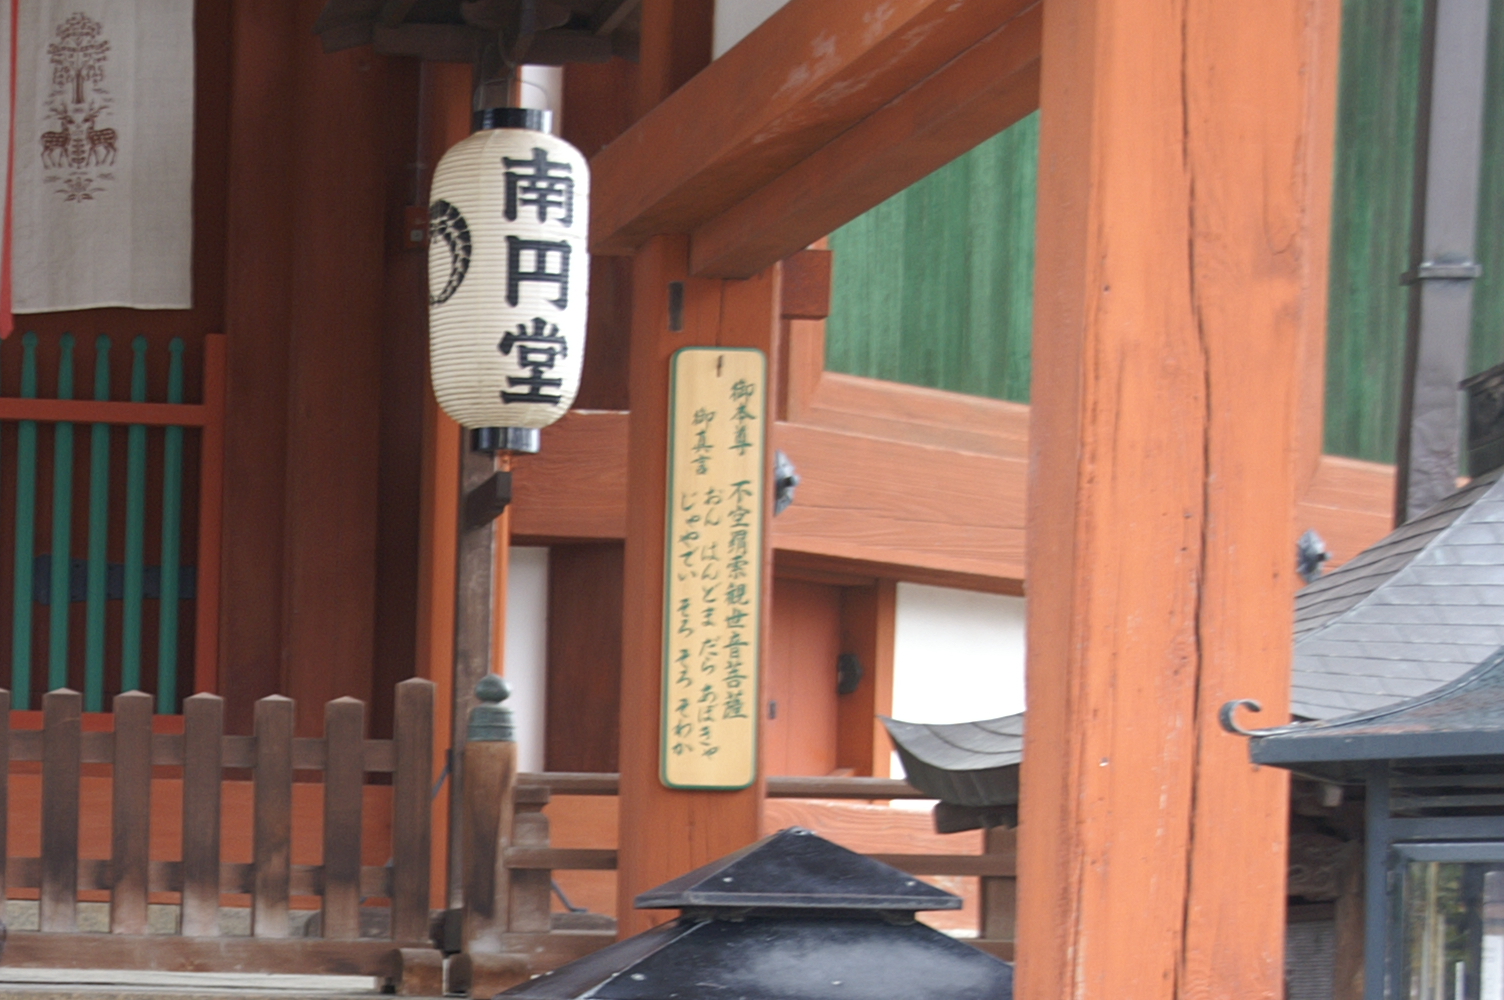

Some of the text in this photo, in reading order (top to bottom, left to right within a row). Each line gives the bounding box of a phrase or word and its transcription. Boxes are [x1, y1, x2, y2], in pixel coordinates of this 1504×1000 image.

[498, 147, 575, 406] 南円堂
[690, 407, 717, 475] 御真言
[728, 379, 757, 457] 御本尊
